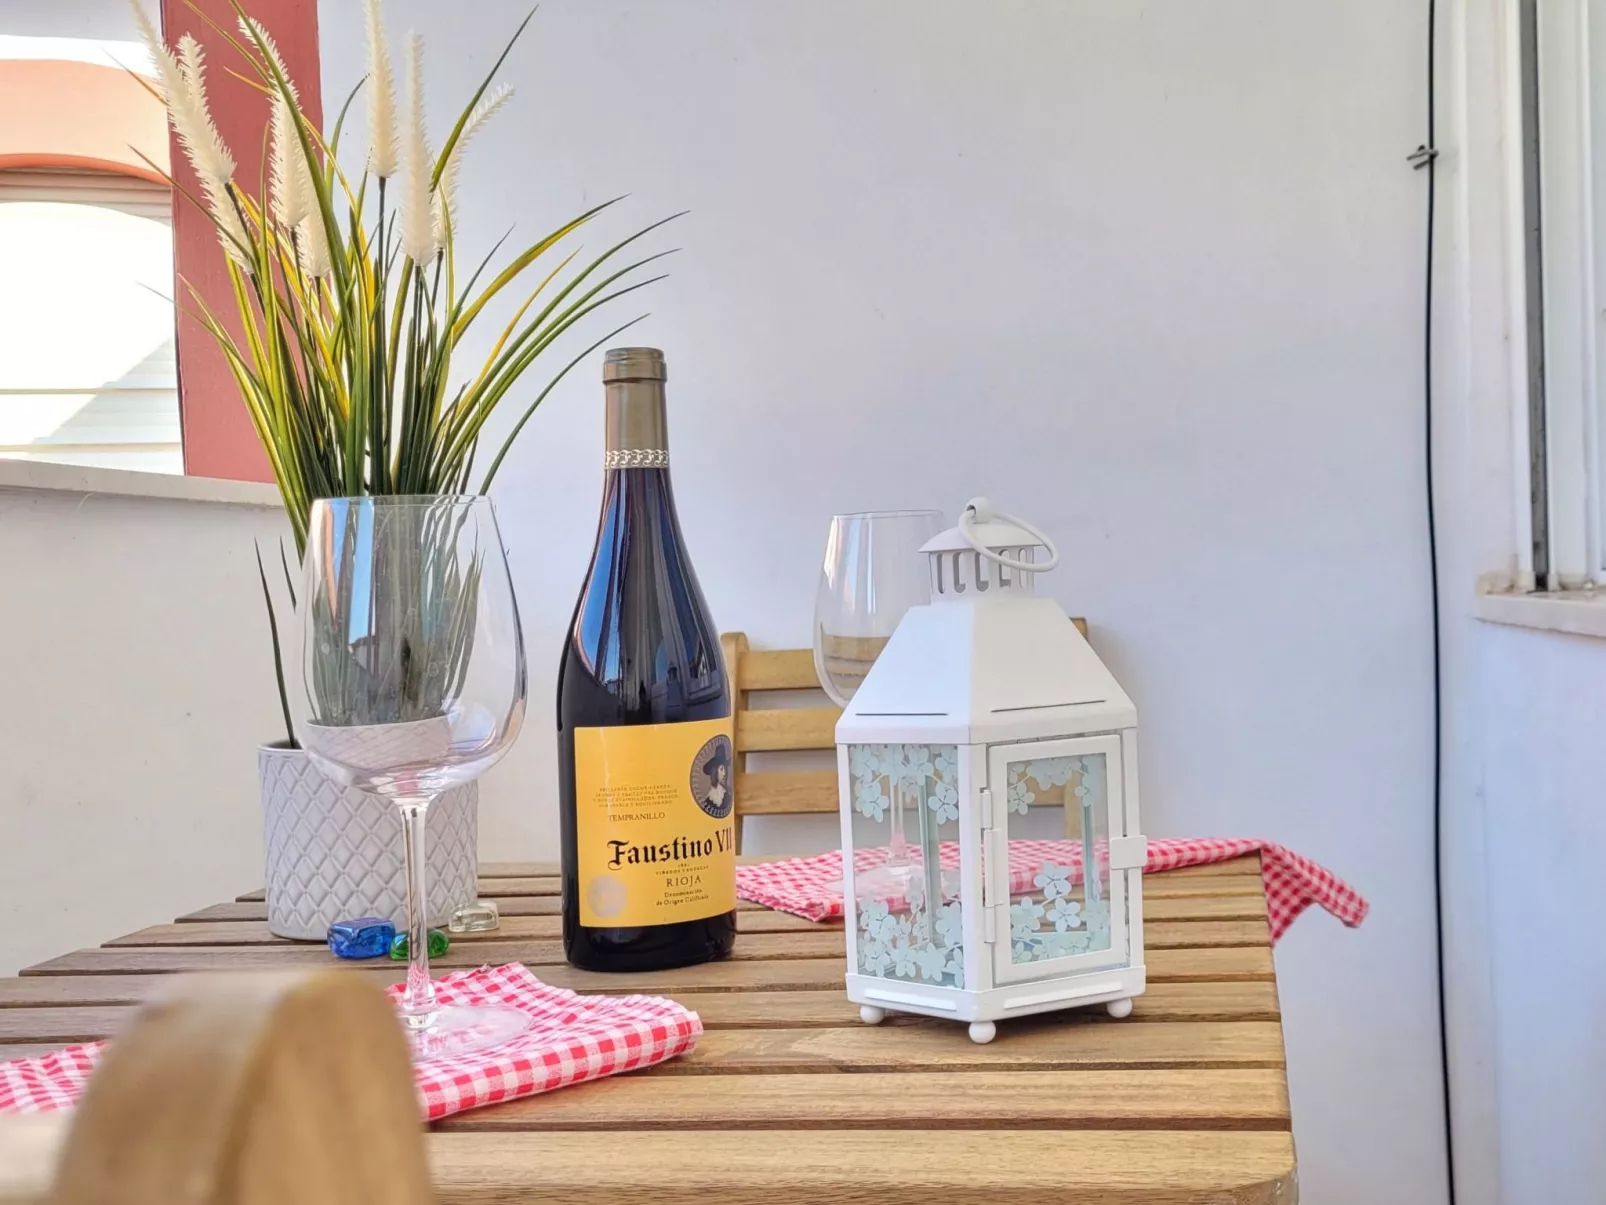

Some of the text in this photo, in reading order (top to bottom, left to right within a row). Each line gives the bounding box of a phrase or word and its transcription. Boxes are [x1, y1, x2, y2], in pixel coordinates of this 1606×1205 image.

[608, 812, 666, 823] TEMPRANILLO
[607, 827, 732, 871] Faustino VII
[666, 875, 702, 888] RIOJA
[663, 898, 684, 907] Origen
